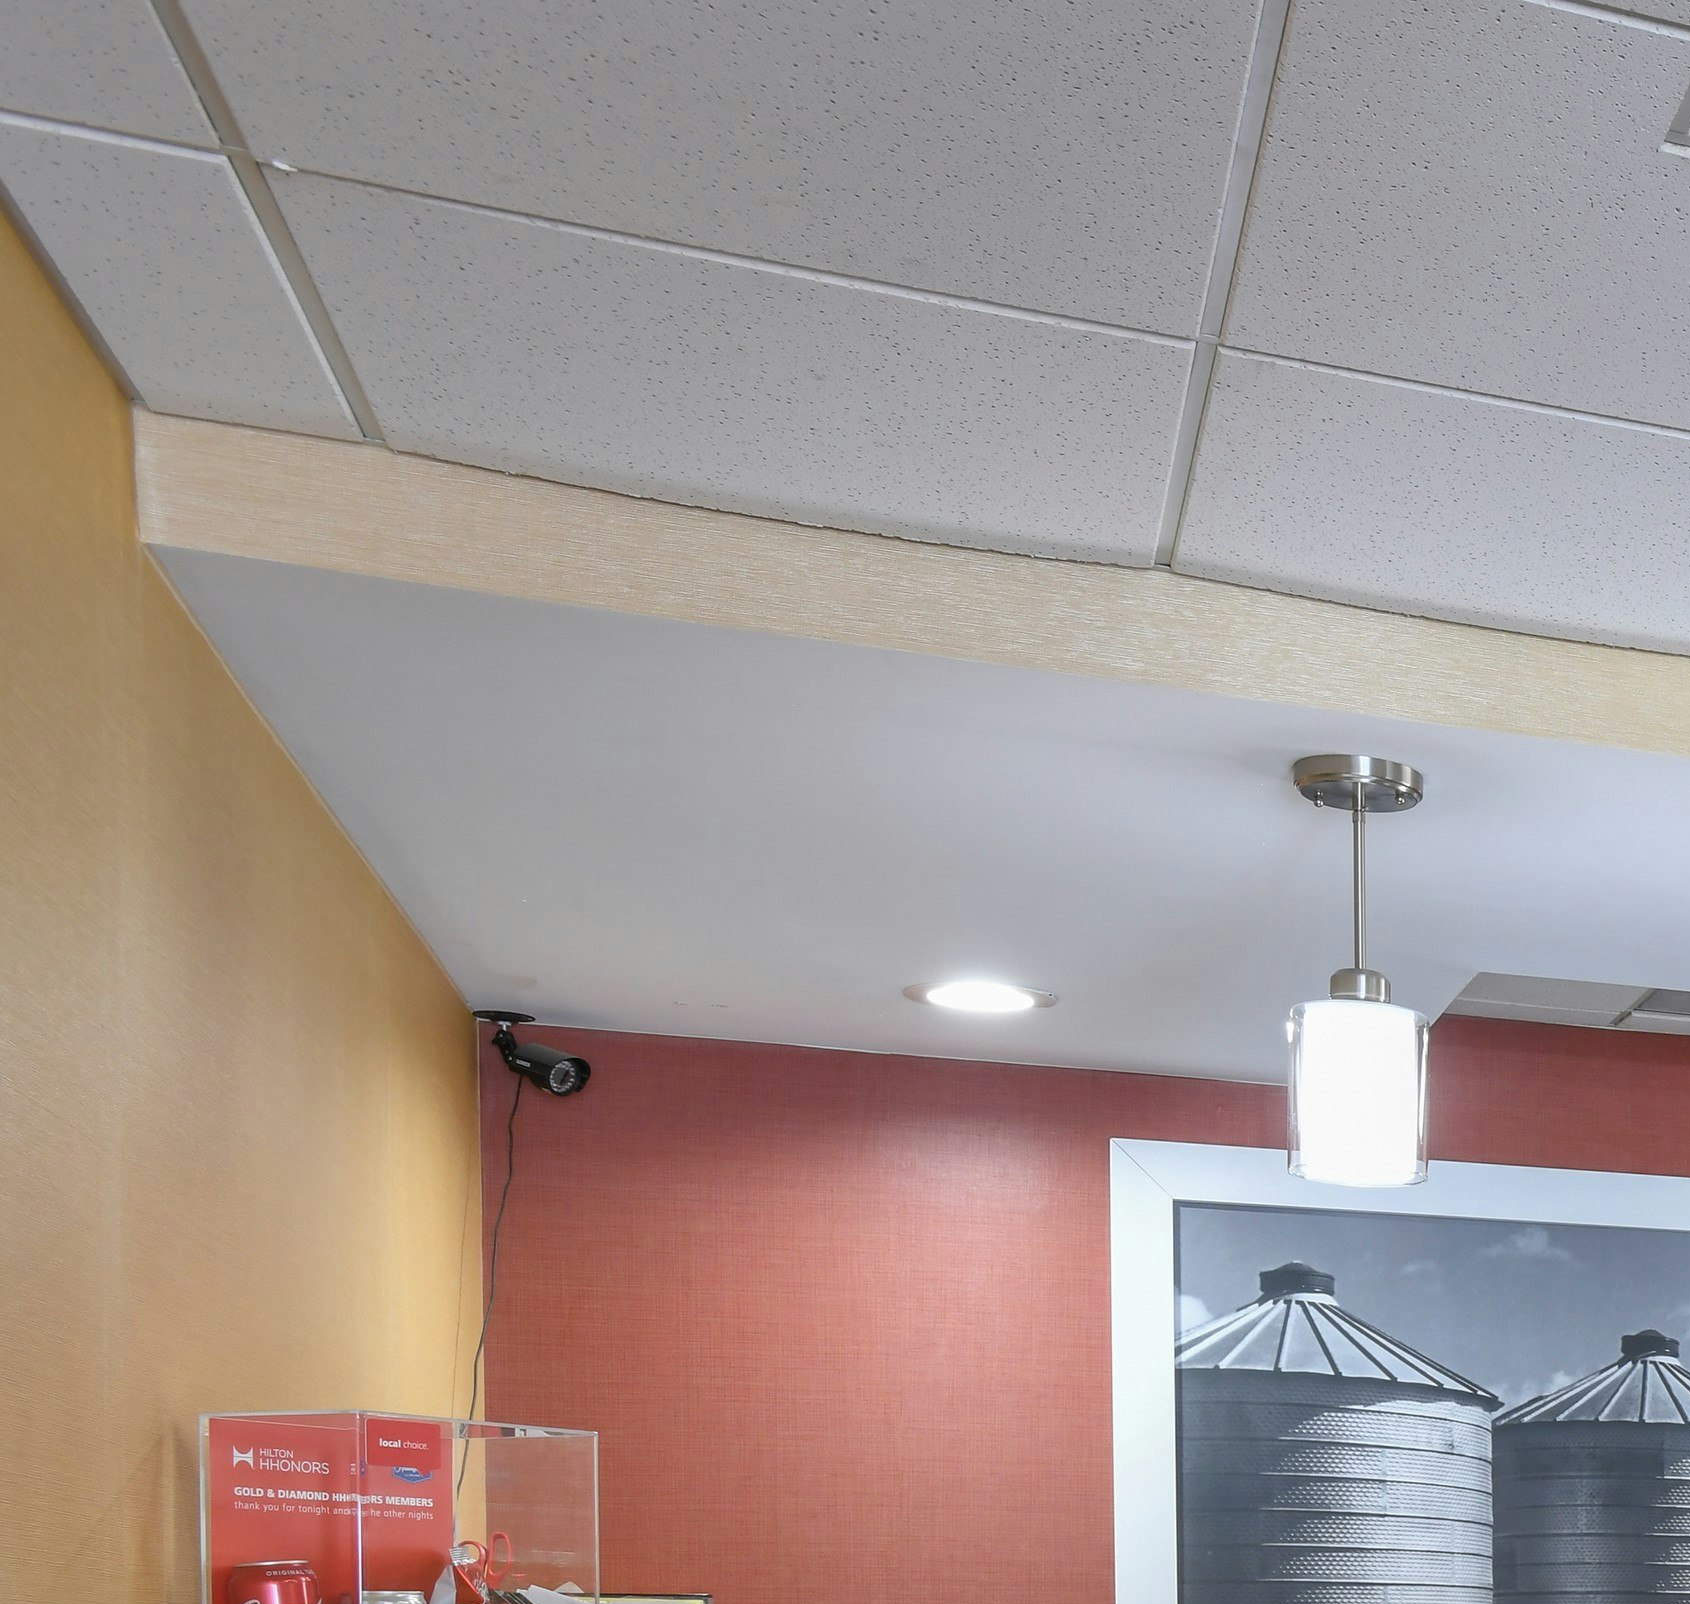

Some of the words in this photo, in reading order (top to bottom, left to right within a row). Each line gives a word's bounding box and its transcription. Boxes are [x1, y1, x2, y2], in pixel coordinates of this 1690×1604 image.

[379, 1438, 401, 1448] local
[259, 1447, 294, 1459] HILTON
[259, 1458, 330, 1475] HHONORS
[234, 1485, 265, 1498] GOLD
[266, 1488, 276, 1499] &
[277, 1489, 330, 1502] DIAMOND
[385, 1496, 434, 1508] MEMBERS
[234, 1500, 260, 1511] thank
[263, 1504, 280, 1515] you
[282, 1502, 296, 1512] for
[298, 1504, 330, 1517] tonight
[370, 1508, 381, 1517] he
[383, 1509, 406, 1519] other
[408, 1510, 434, 1521] nights
